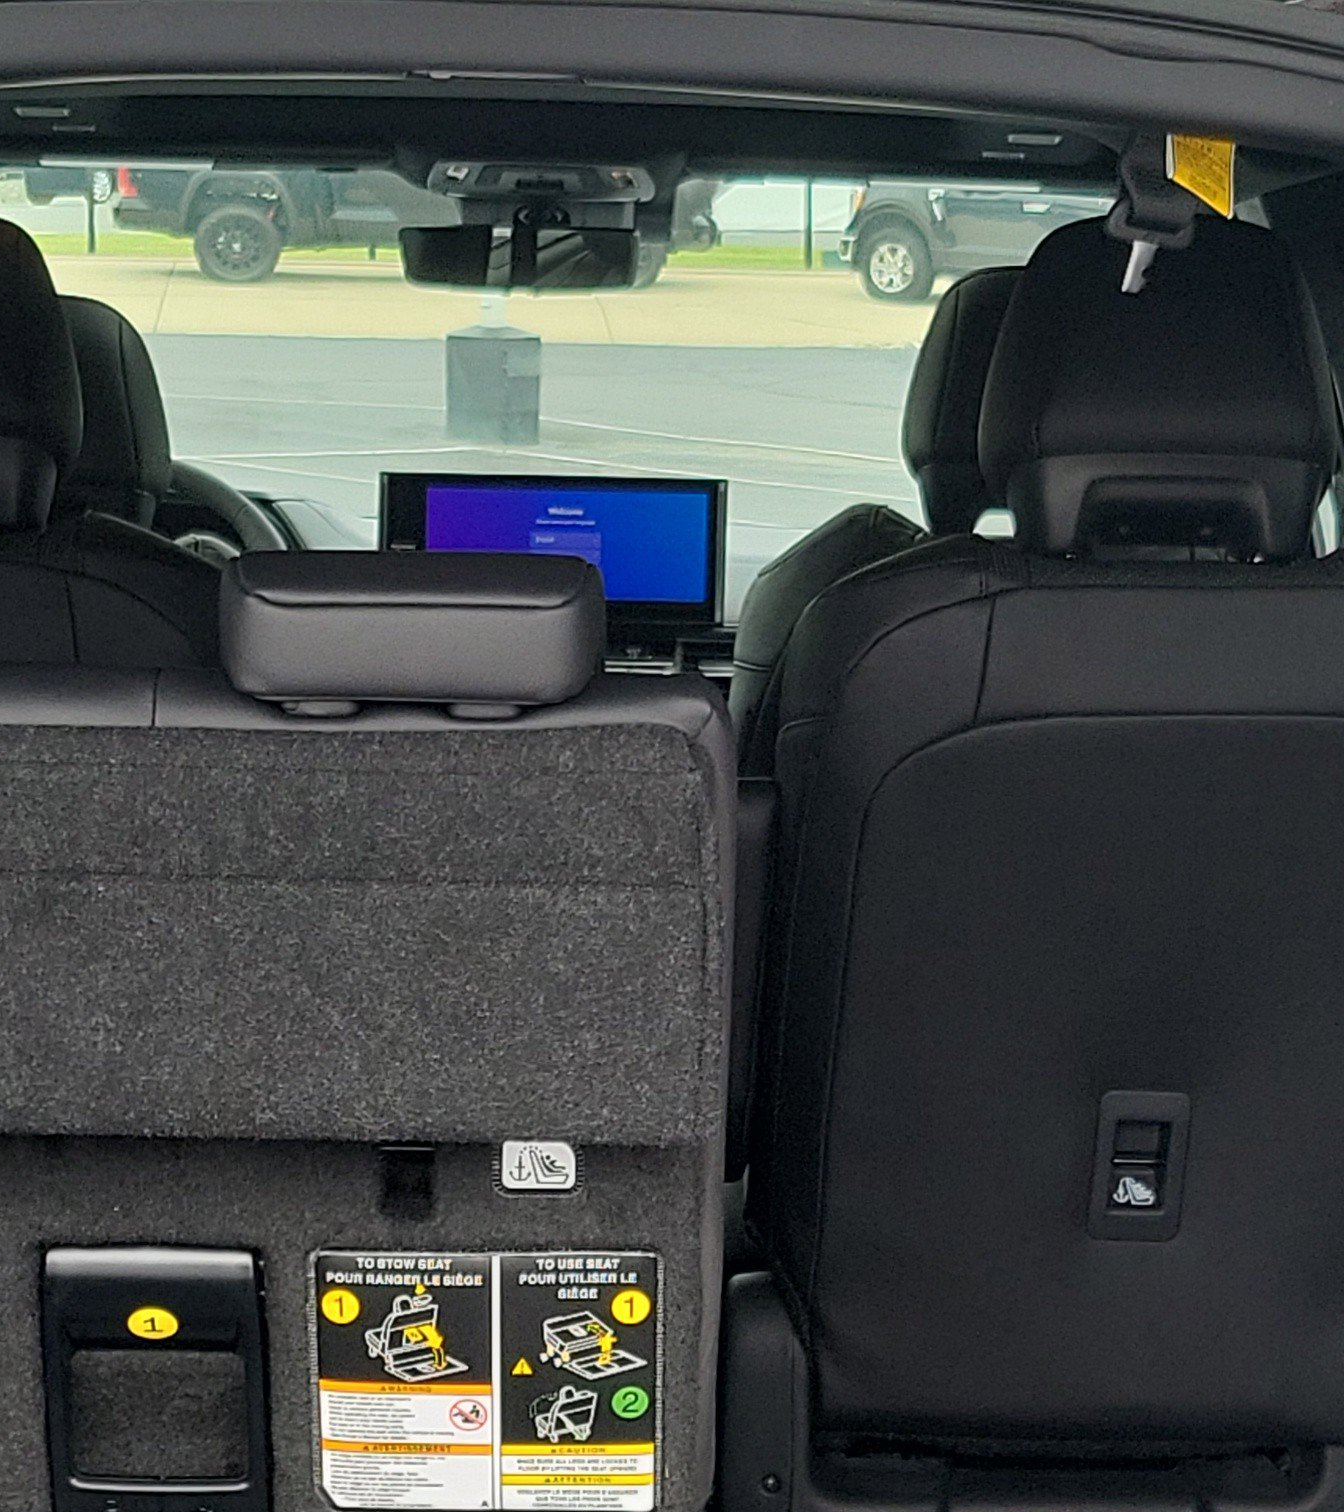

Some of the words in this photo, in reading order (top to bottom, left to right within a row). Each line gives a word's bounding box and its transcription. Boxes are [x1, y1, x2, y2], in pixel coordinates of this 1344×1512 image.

[355, 1257, 374, 1270] TO
[377, 1258, 416, 1270] STOW
[417, 1259, 453, 1271] SEAT
[535, 1258, 555, 1270] TO
[557, 1258, 584, 1270] USE
[586, 1258, 620, 1270] SEAT
[325, 1271, 363, 1284] POUR
[366, 1273, 420, 1286] RANGER
[424, 1274, 441, 1286] LE
[518, 1273, 556, 1285] POUR
[558, 1272, 618, 1285] UTILISER
[620, 1272, 638, 1284] LE
[625, 1297, 635, 1318] 1
[143, 1316, 164, 1333] 1
[621, 1392, 639, 1413] 2
